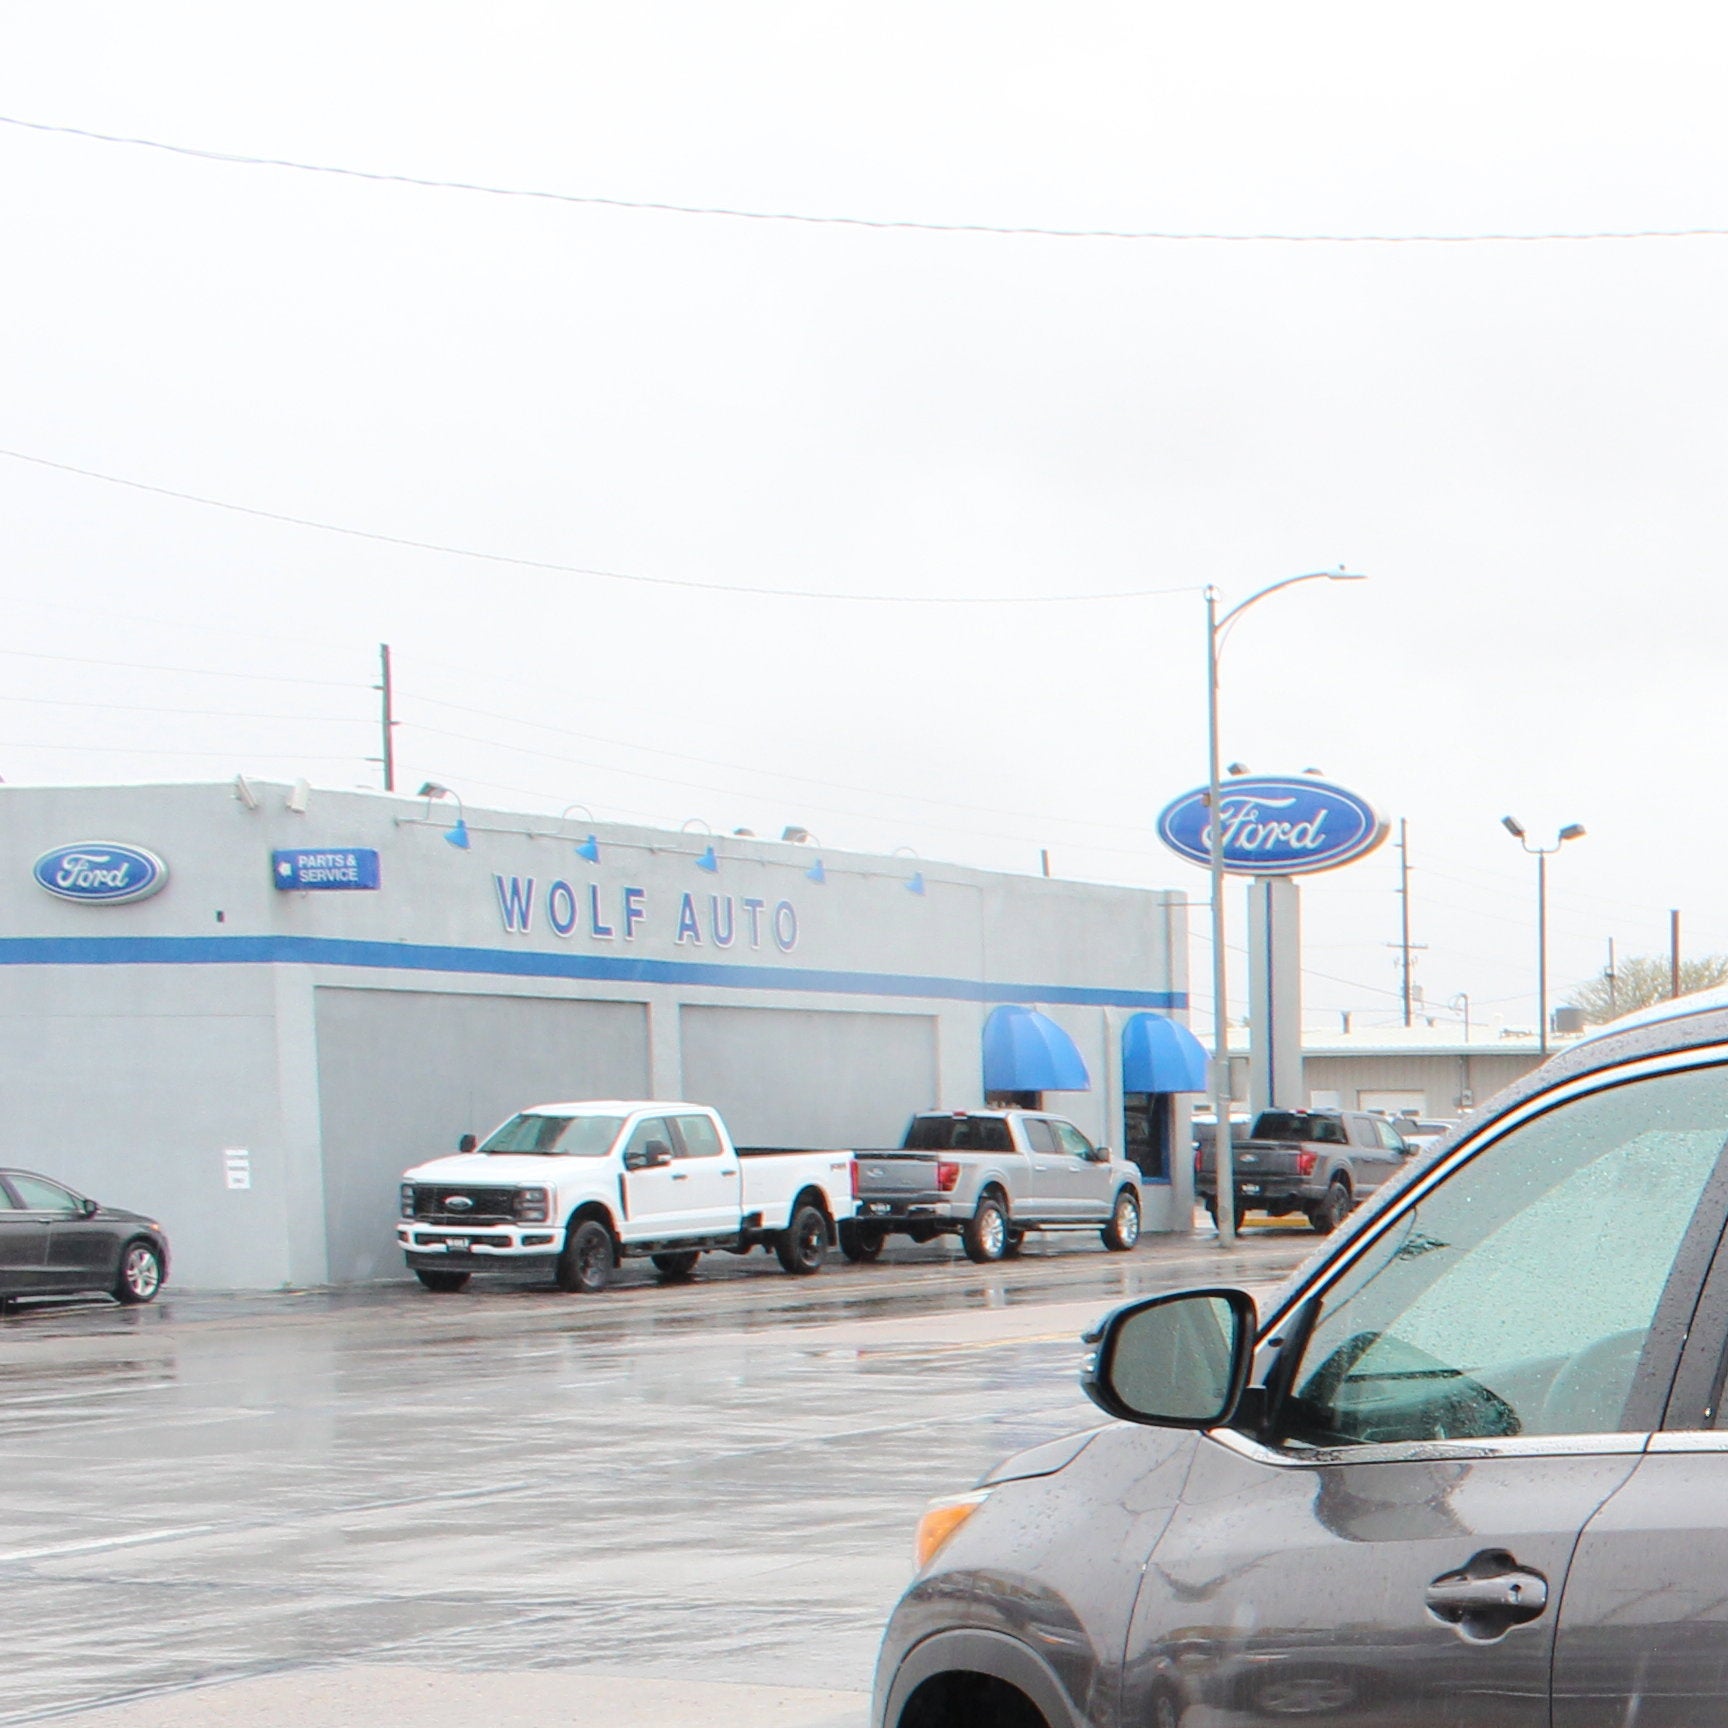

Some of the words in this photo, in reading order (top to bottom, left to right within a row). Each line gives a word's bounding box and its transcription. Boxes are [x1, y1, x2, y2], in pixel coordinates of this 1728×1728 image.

[1201, 795, 1328, 850] Ford
[56, 853, 130, 888] Ford
[298, 854, 345, 868] PARTS
[346, 854, 358, 867] &
[299, 868, 359, 882] SERVICE
[493, 872, 648, 942] WOLF
[674, 889, 801, 954] AUTO
